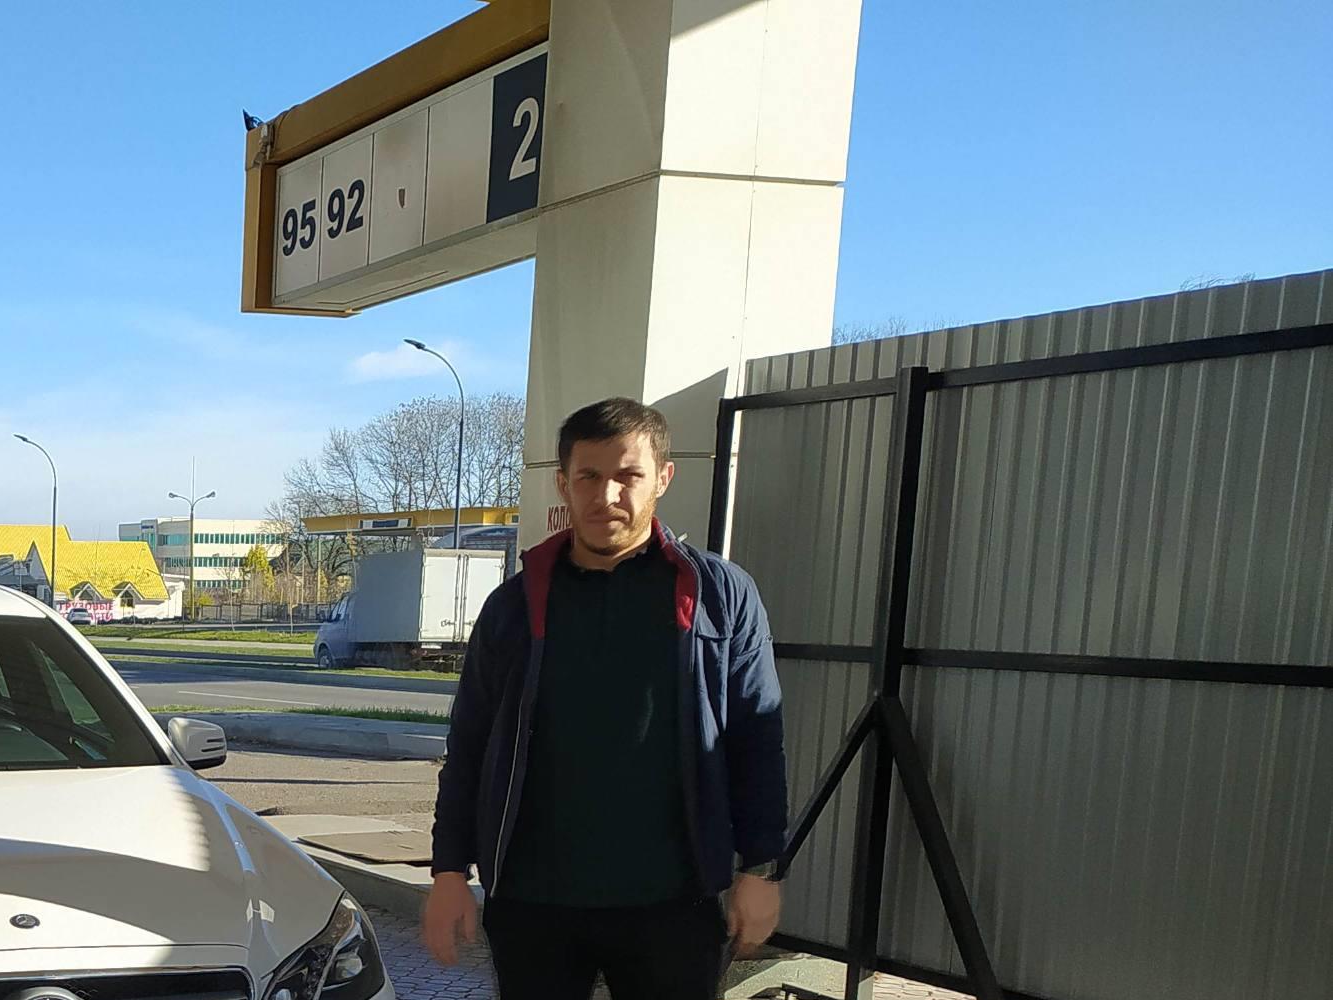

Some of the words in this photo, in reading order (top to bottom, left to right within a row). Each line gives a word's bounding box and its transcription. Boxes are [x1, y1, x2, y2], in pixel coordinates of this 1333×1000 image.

[508, 97, 540, 181] 2
[282, 199, 316, 257] 95
[327, 178, 365, 240] 92
